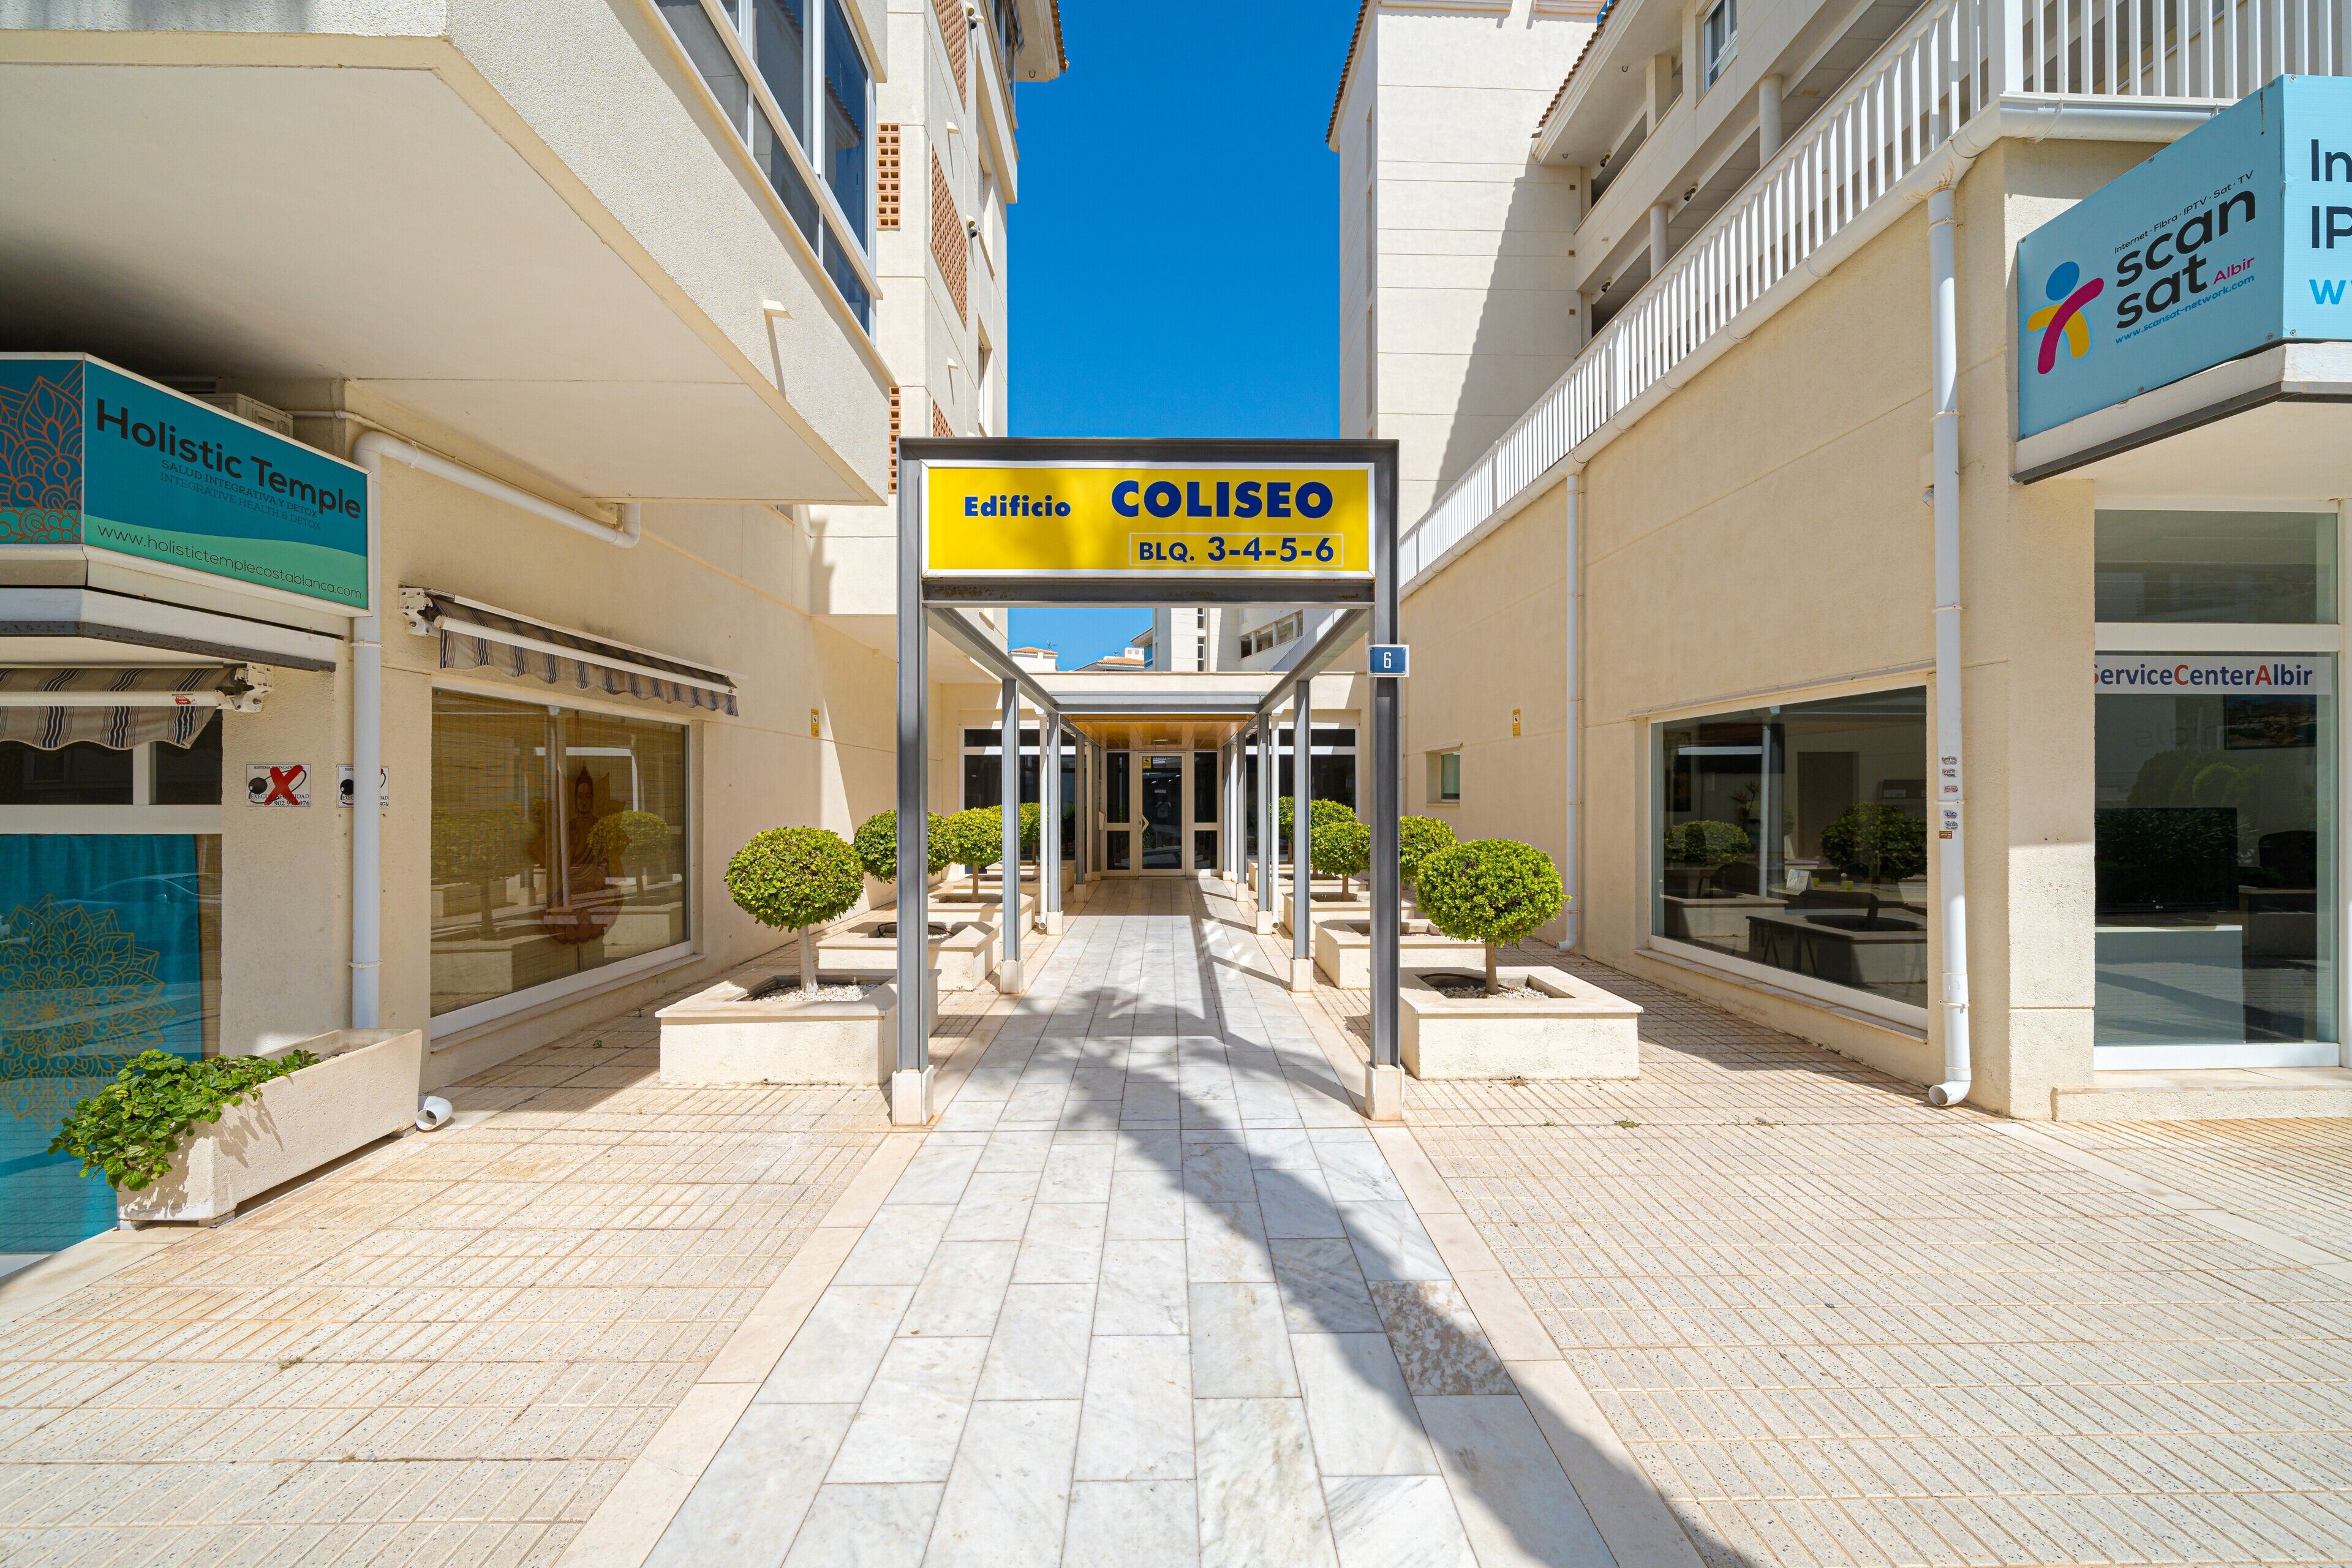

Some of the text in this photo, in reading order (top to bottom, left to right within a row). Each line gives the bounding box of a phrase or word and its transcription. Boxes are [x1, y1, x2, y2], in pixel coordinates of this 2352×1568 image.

[2114, 170, 2254, 254] Internet Fibra IPTV Sat TV
[2116, 190, 2256, 287] scan
[2115, 275, 2255, 344] www.scansat-network.com
[2116, 253, 2255, 329] sat Albir
[97, 398, 361, 519] Holistic Temple
[162, 459, 318, 518] SALUD INTEGRATIVA Y DETOX
[160, 472, 322, 530] INTEGRATIVE HEALTH & DETOX
[964, 480, 1333, 519] Edificio COLISEO
[97, 525, 362, 600] www.holistictemplecostablanca.com
[1139, 536, 1334, 563] BLQ. 3-4-5-6
[1383, 652, 1392, 669] 6
